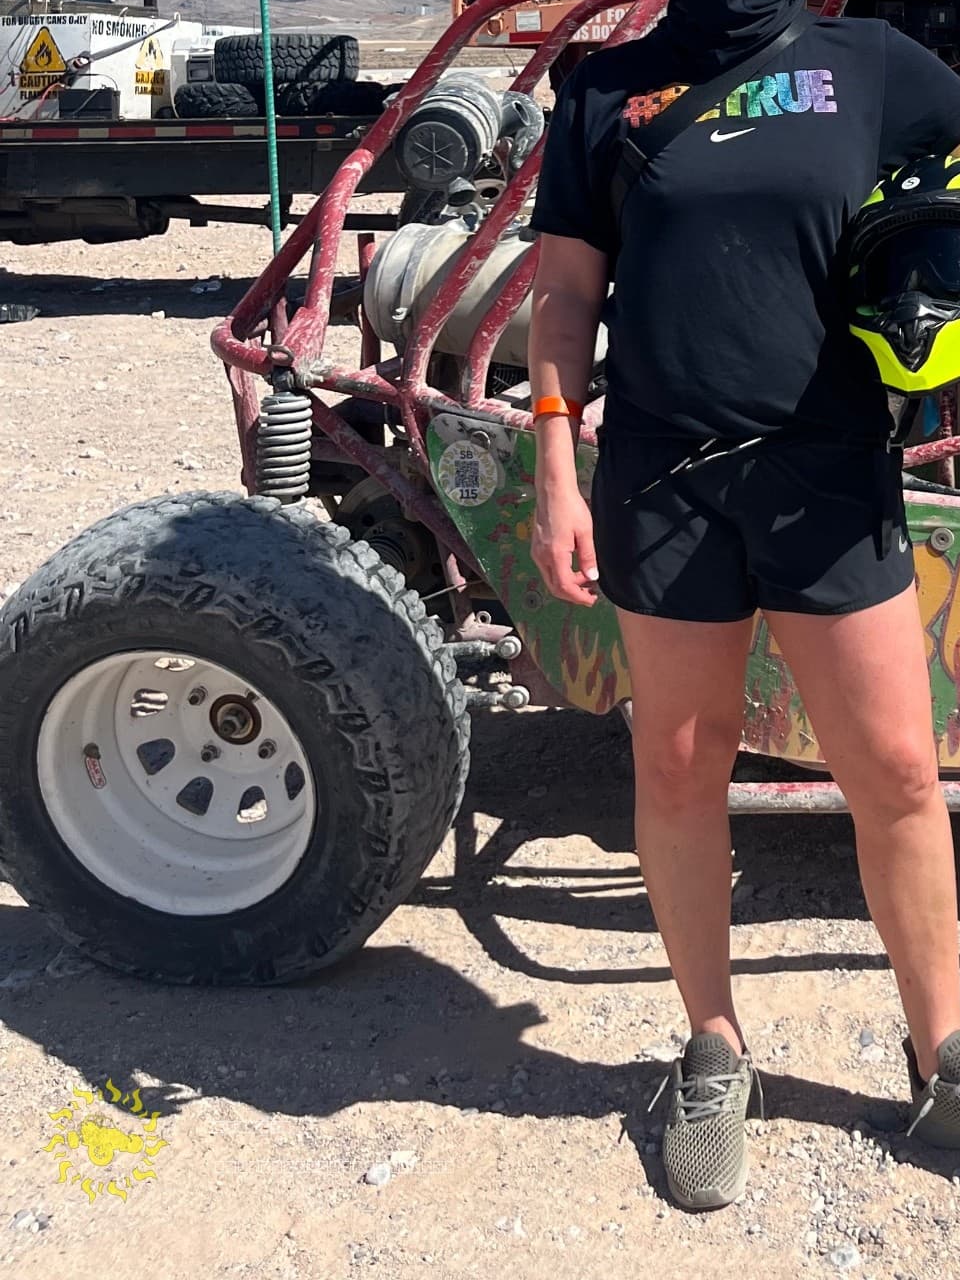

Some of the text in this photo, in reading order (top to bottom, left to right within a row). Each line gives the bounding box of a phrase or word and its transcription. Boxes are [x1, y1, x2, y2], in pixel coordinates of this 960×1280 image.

[46, 16, 67, 25] CANS
[92, 20, 148, 38] NO SMOKING
[460, 451, 473, 460] SB
[459, 489, 478, 500] 115
